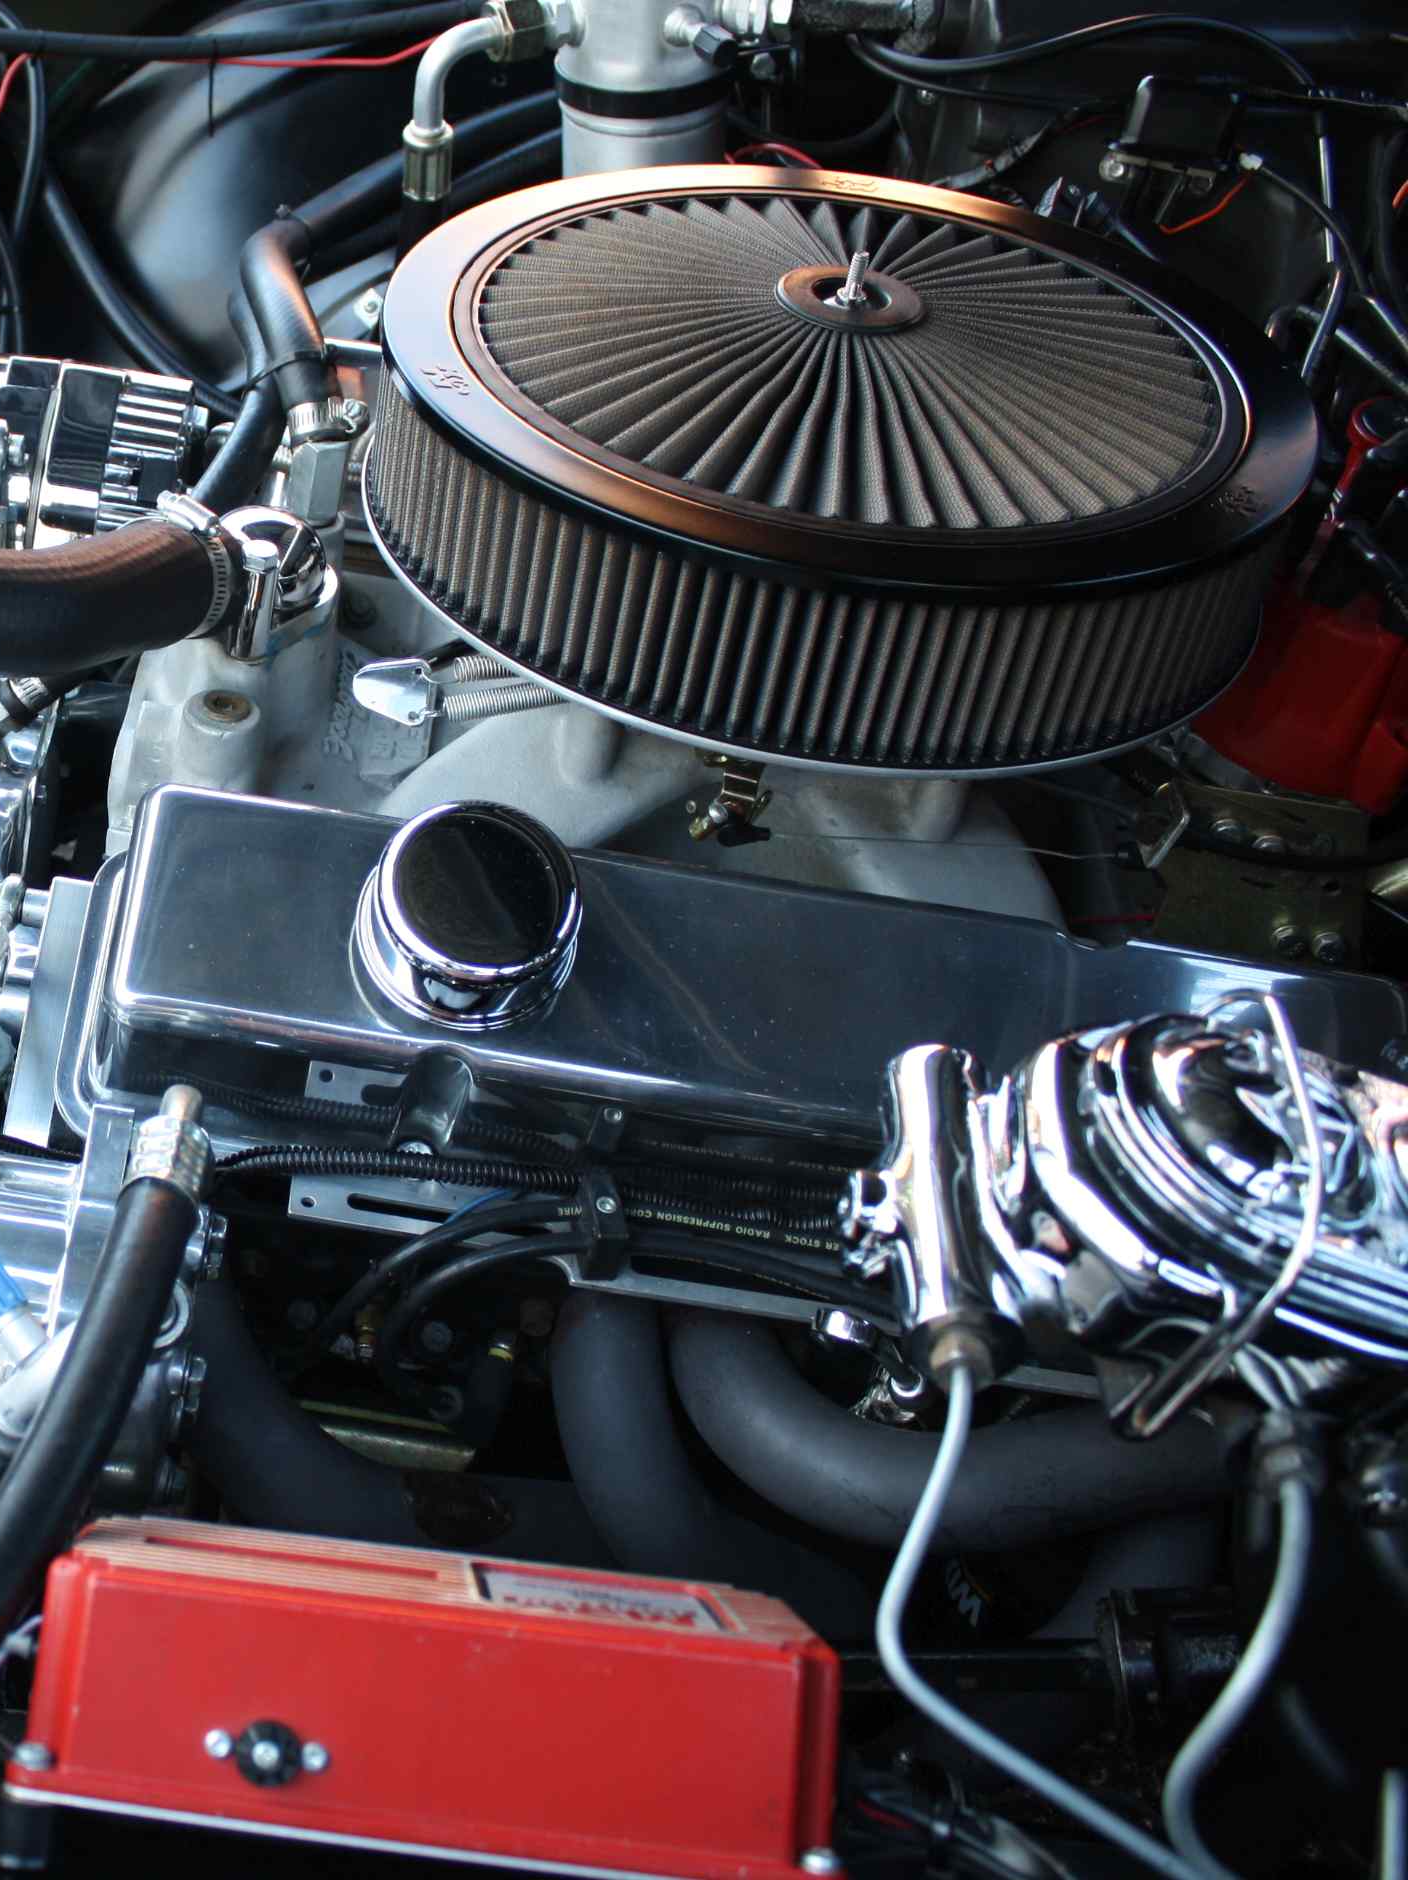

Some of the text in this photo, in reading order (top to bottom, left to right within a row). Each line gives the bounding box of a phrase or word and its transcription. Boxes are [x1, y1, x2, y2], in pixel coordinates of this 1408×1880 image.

[557, 1206, 583, 1216] WIRE
[657, 1211, 731, 1232] SUPPRESSION
[736, 1225, 770, 1240] RADIO
[785, 1233, 821, 1248] STOCK
